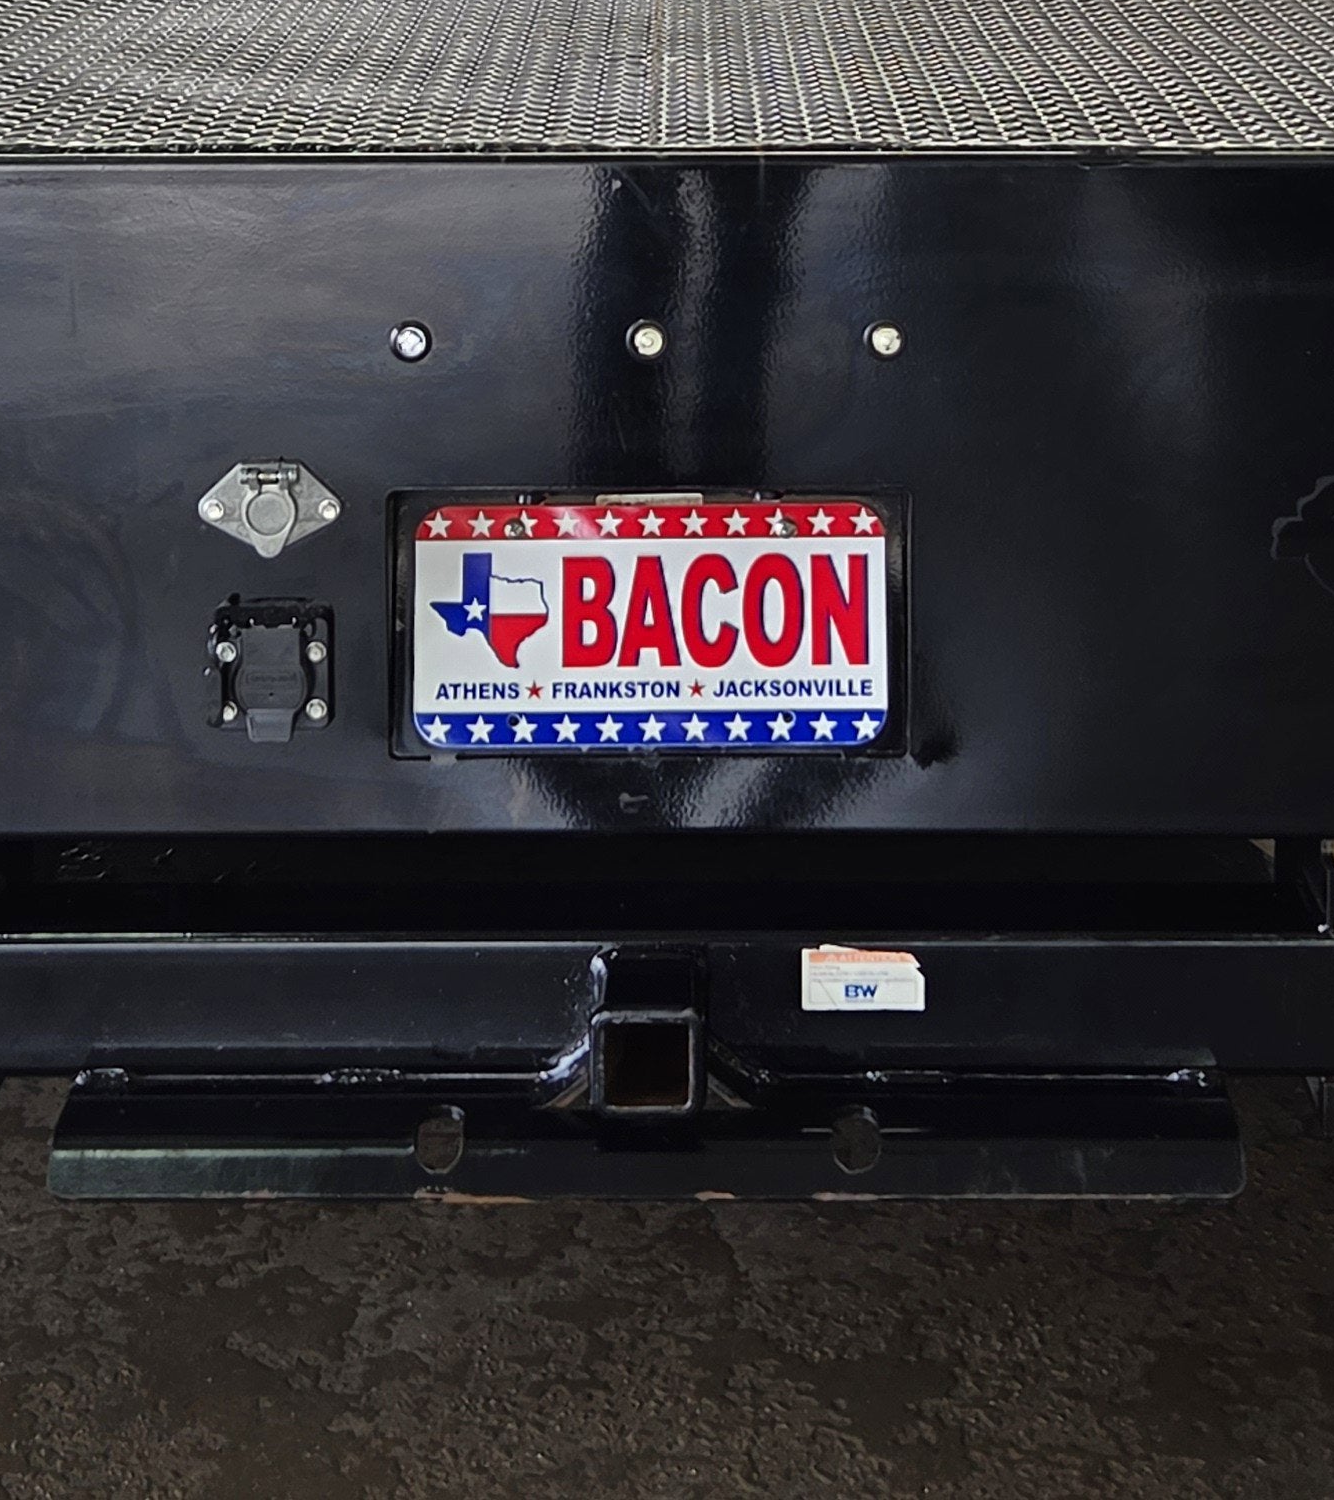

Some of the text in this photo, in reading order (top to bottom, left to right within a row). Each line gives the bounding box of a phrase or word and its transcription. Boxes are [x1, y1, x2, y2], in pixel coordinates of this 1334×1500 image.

[561, 553, 869, 668] BACON
[435, 678, 874, 701] ATHENS FRANKSTON JACKSONVILLE
